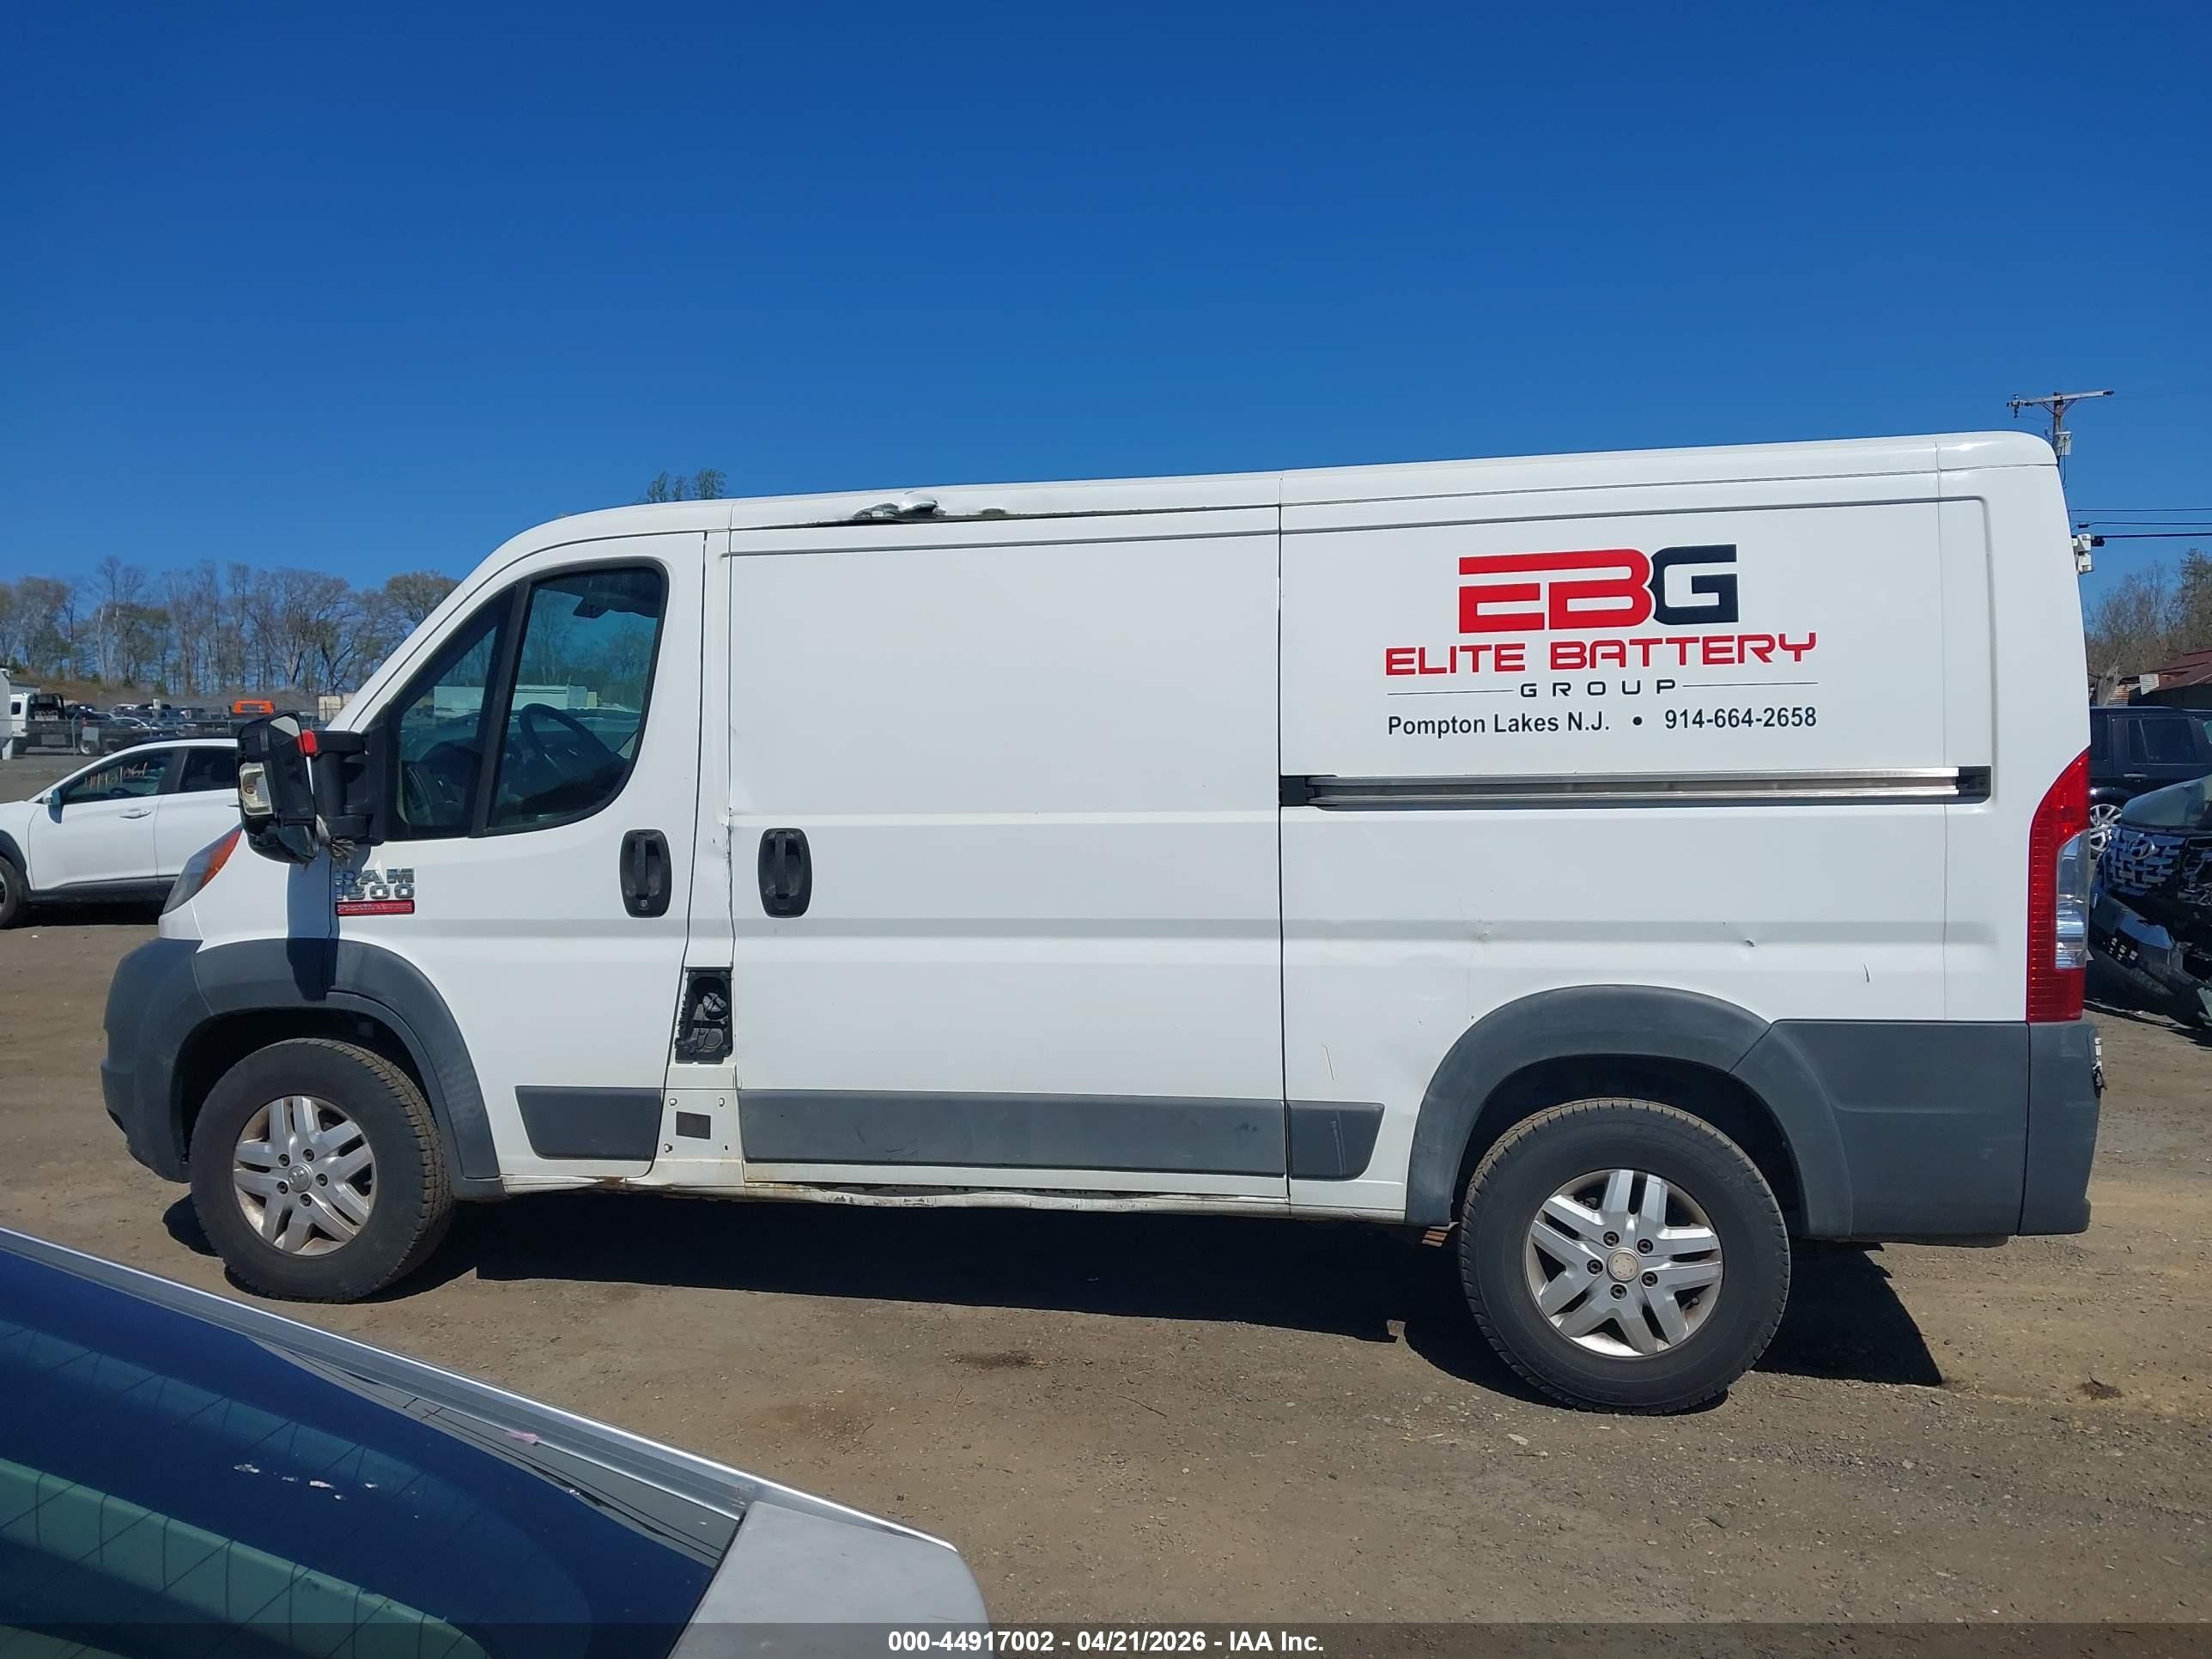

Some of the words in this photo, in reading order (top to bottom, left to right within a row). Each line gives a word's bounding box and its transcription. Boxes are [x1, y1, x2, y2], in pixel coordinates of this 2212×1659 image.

[1458, 544, 1740, 634] EBG
[1386, 643, 1526, 676] ELITE
[1550, 632, 1816, 671] BATTERY
[1520, 678, 1676, 698] GROUP
[1388, 714, 1486, 739] Pompton
[1494, 711, 1559, 733] Lakes
[1568, 711, 1610, 732] N.J.
[1664, 706, 1817, 730] 914-664-2658
[333, 868, 416, 887] RAM
